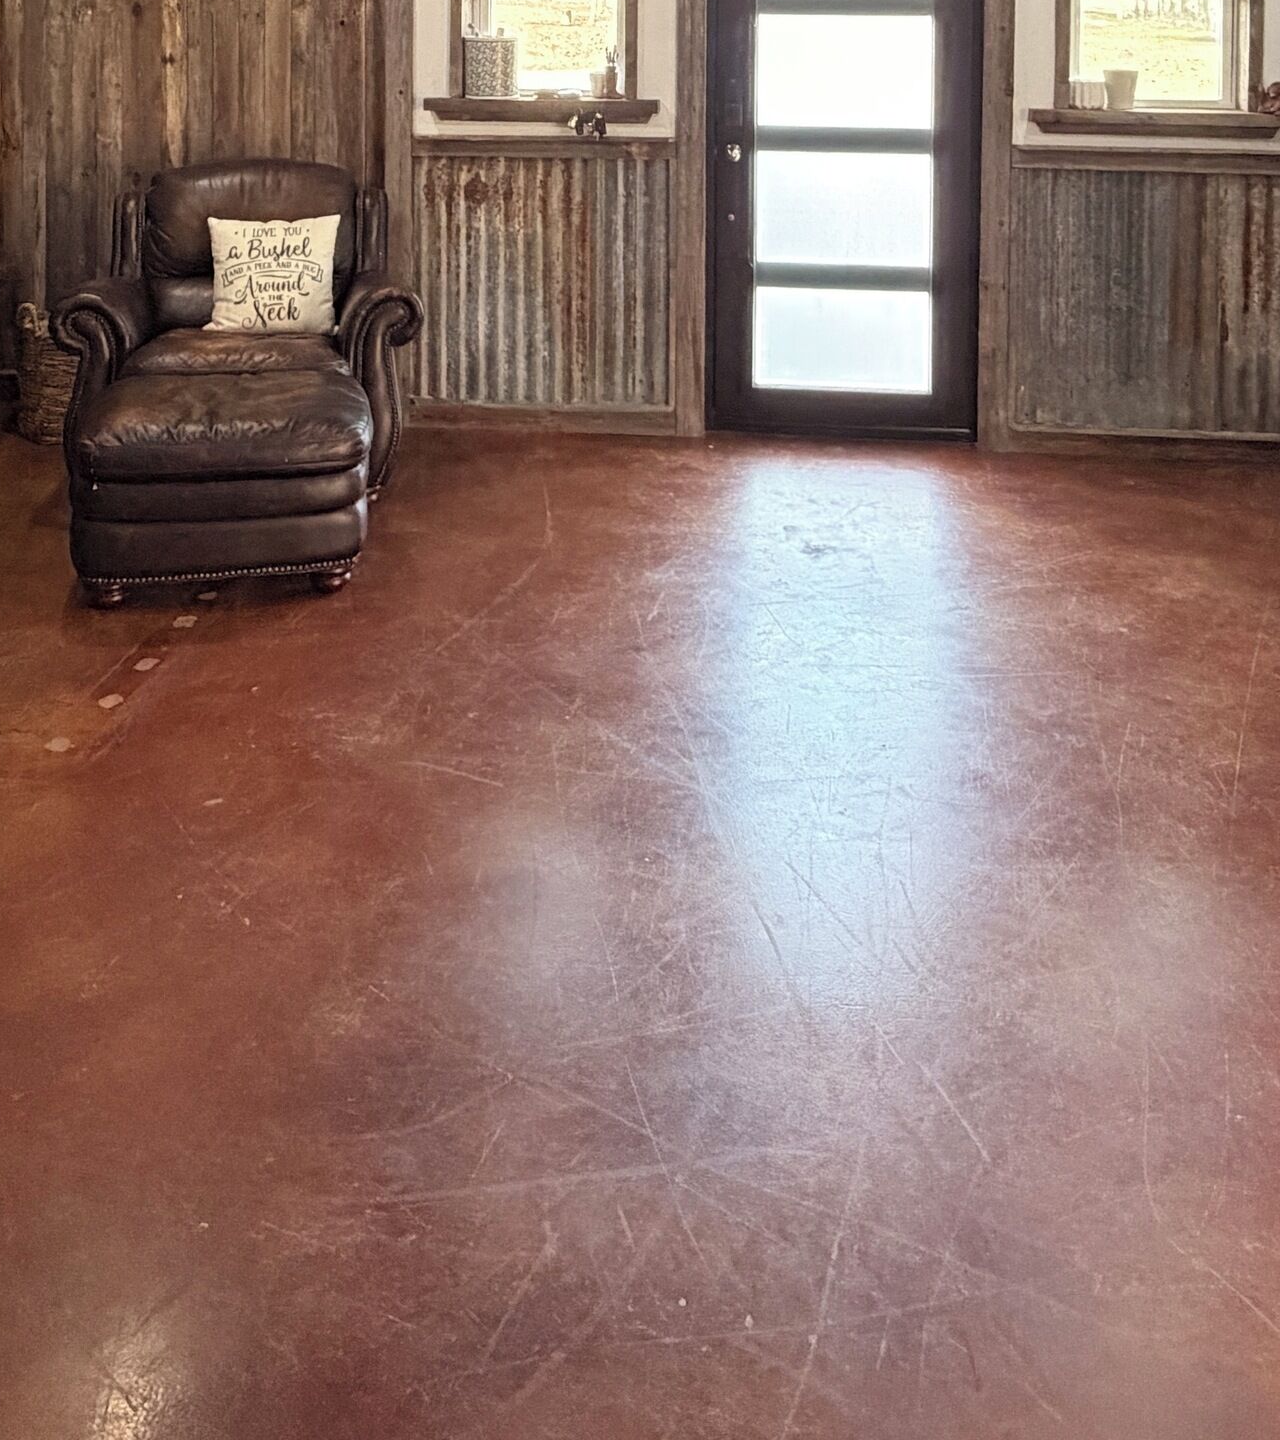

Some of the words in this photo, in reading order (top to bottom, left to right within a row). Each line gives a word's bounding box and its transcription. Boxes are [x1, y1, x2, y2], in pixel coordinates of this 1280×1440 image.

[252, 228, 277, 238] LOVE
[283, 227, 302, 237] YOU
[225, 245, 243, 261] a
[247, 236, 312, 262] Bushel
[229, 267, 244, 277] AND
[254, 262, 272, 270] PECK
[275, 261, 292, 269] AND
[234, 271, 309, 300] Around
[242, 297, 300, 329] Neck
